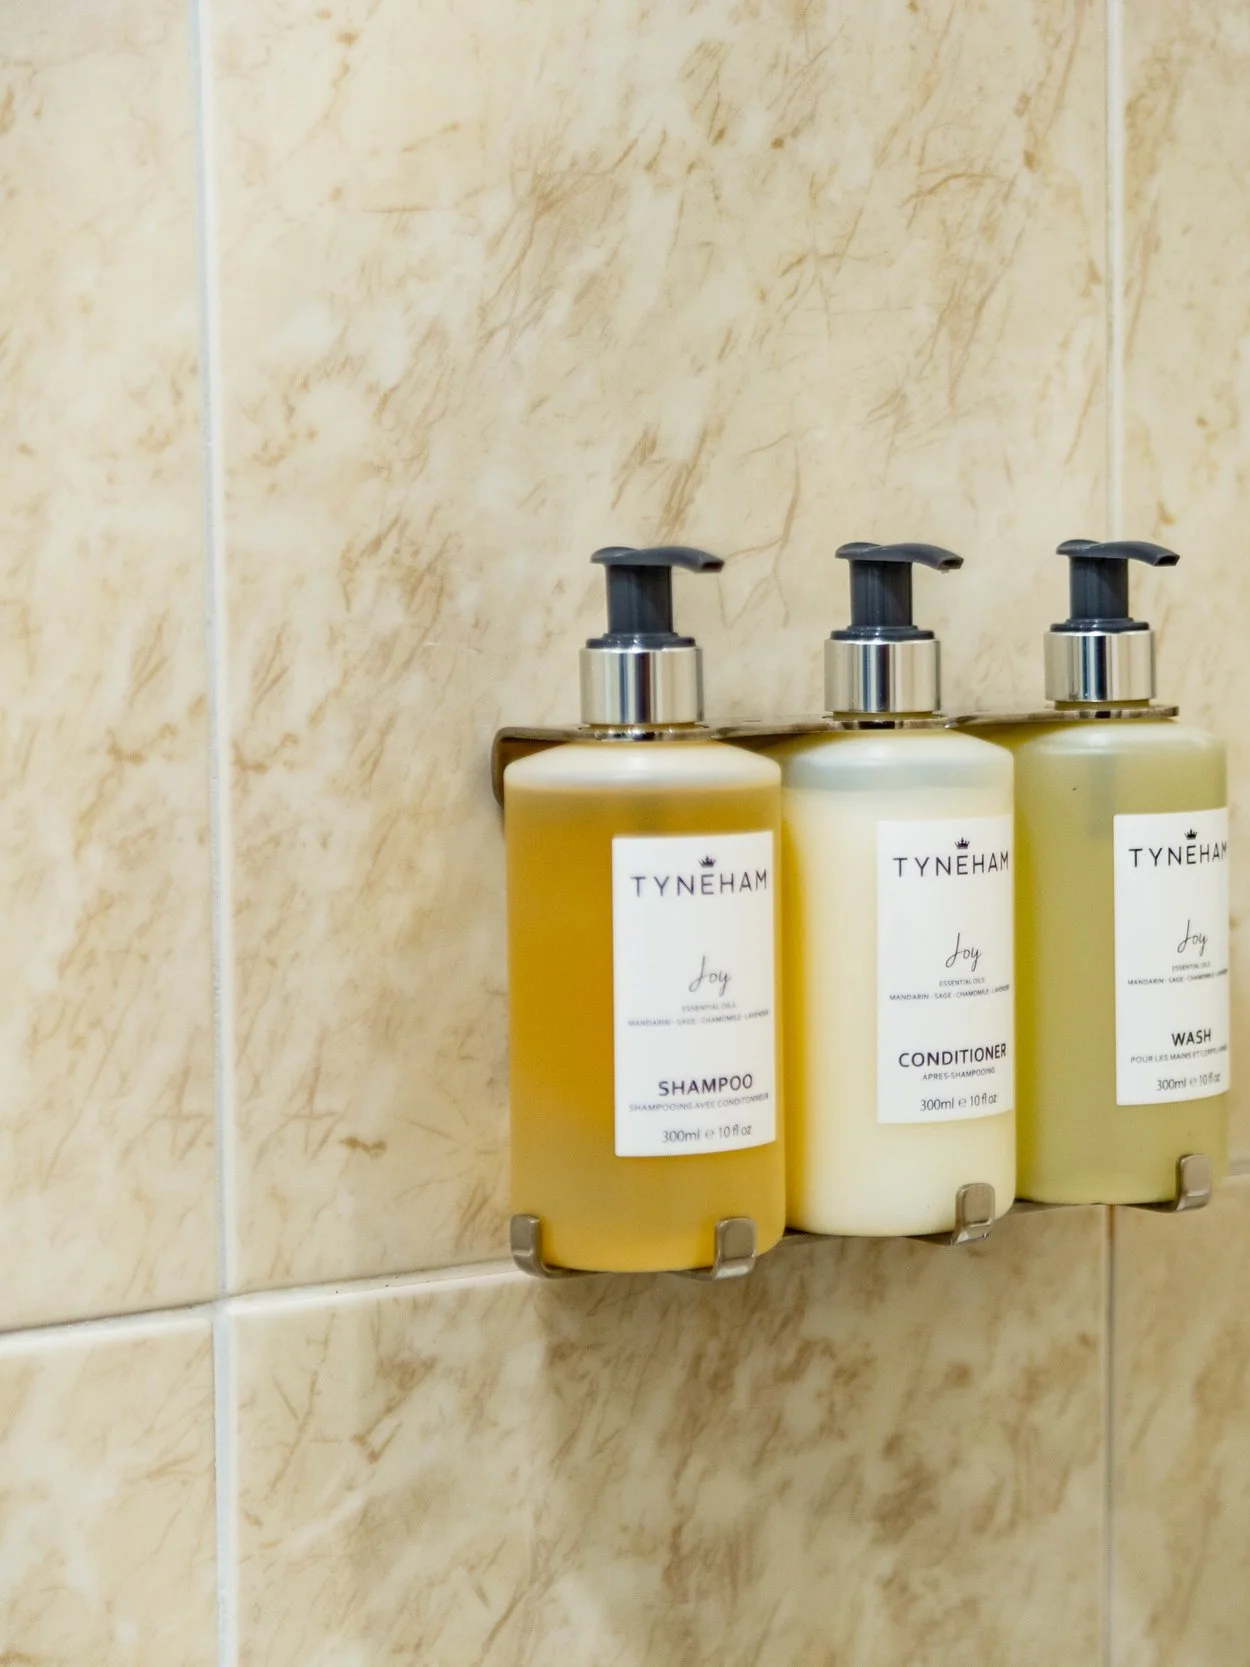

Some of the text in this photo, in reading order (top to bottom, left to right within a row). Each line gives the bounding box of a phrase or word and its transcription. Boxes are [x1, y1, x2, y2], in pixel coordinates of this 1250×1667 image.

[893, 851, 1008, 877] TYNEHAM
[630, 869, 767, 897] TYNEHAM
[1177, 919, 1208, 957] Joy
[945, 932, 981, 972] Joy
[688, 956, 731, 997] Joy
[939, 979, 972, 987] ESSENTIAL
[934, 992, 952, 1000] SAGE
[1171, 1028, 1212, 1047] WASH
[898, 1043, 1006, 1068] CONDITIONER
[1130, 1056, 1154, 1064] POUR
[1155, 1054, 1168, 1063] LES
[1170, 1051, 1192, 1062] MAINS
[658, 1073, 753, 1097] SHAMPOO
[1156, 1078, 1186, 1091] 300ml
[629, 1101, 692, 1113] SHAMPOOING
[695, 1099, 716, 1110] AVEC
[920, 1097, 954, 1112] 300ml
[970, 1095, 980, 1107] 10
[988, 1094, 997, 1104] oz
[661, 1128, 700, 1143] 300ml
[719, 1126, 731, 1139] 10
[741, 1124, 752, 1136] oz
